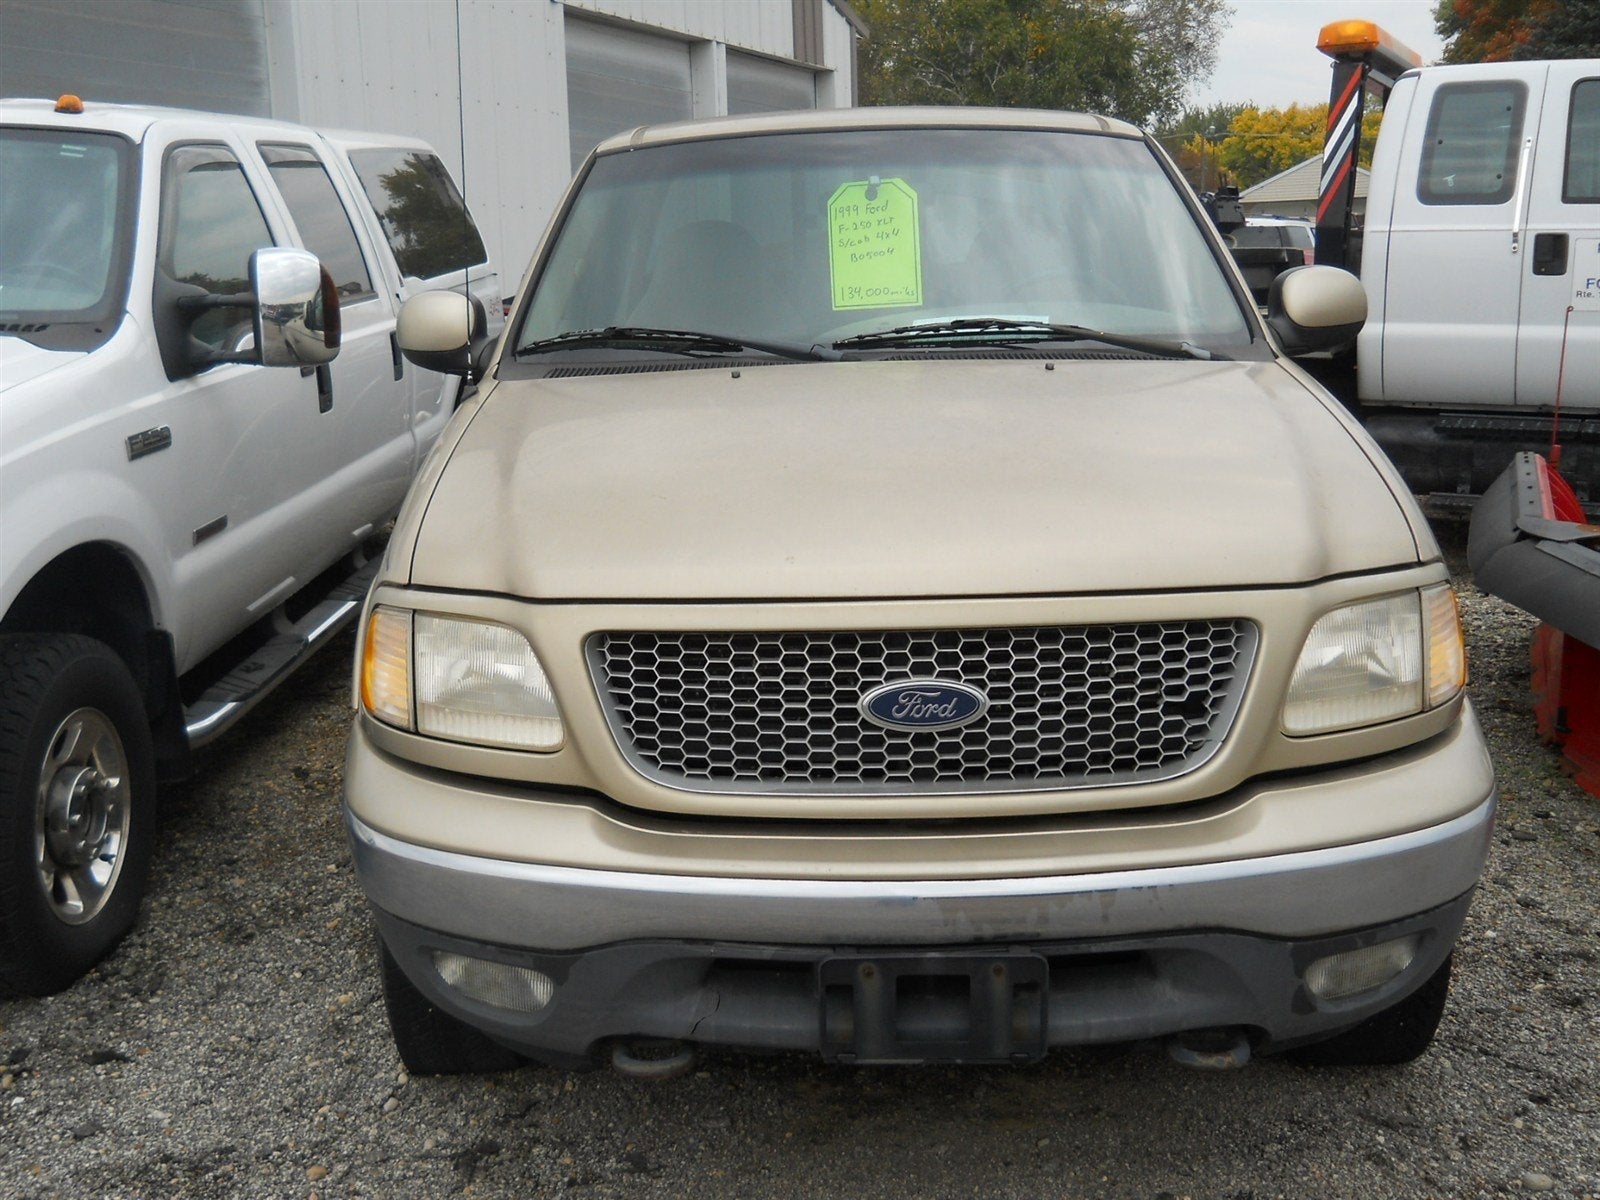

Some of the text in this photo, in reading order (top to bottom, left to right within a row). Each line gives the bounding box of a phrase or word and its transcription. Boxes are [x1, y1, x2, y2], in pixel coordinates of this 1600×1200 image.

[834, 200, 889, 221] 1999 Ford
[891, 690, 958, 719] Ford
